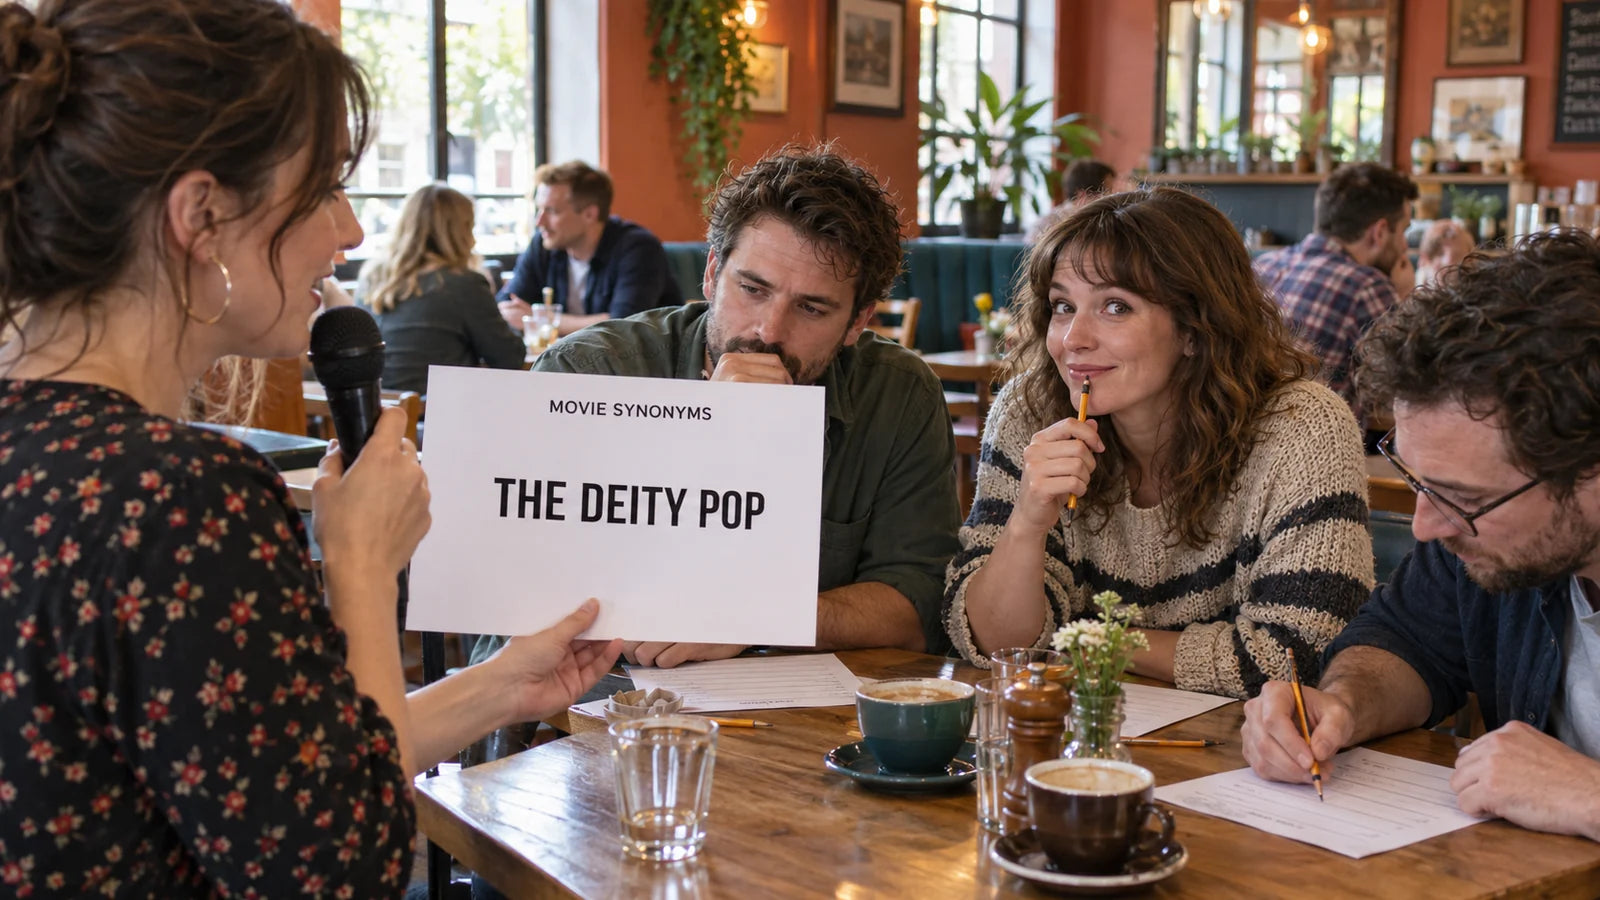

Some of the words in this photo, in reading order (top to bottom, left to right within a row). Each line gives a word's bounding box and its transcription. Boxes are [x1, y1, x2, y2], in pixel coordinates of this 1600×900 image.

[549, 399, 607, 416] MOVIE
[613, 402, 712, 421] SYNONYMS
[494, 477, 567, 521] THE
[580, 482, 687, 527] DEITY
[699, 489, 765, 530] POP
